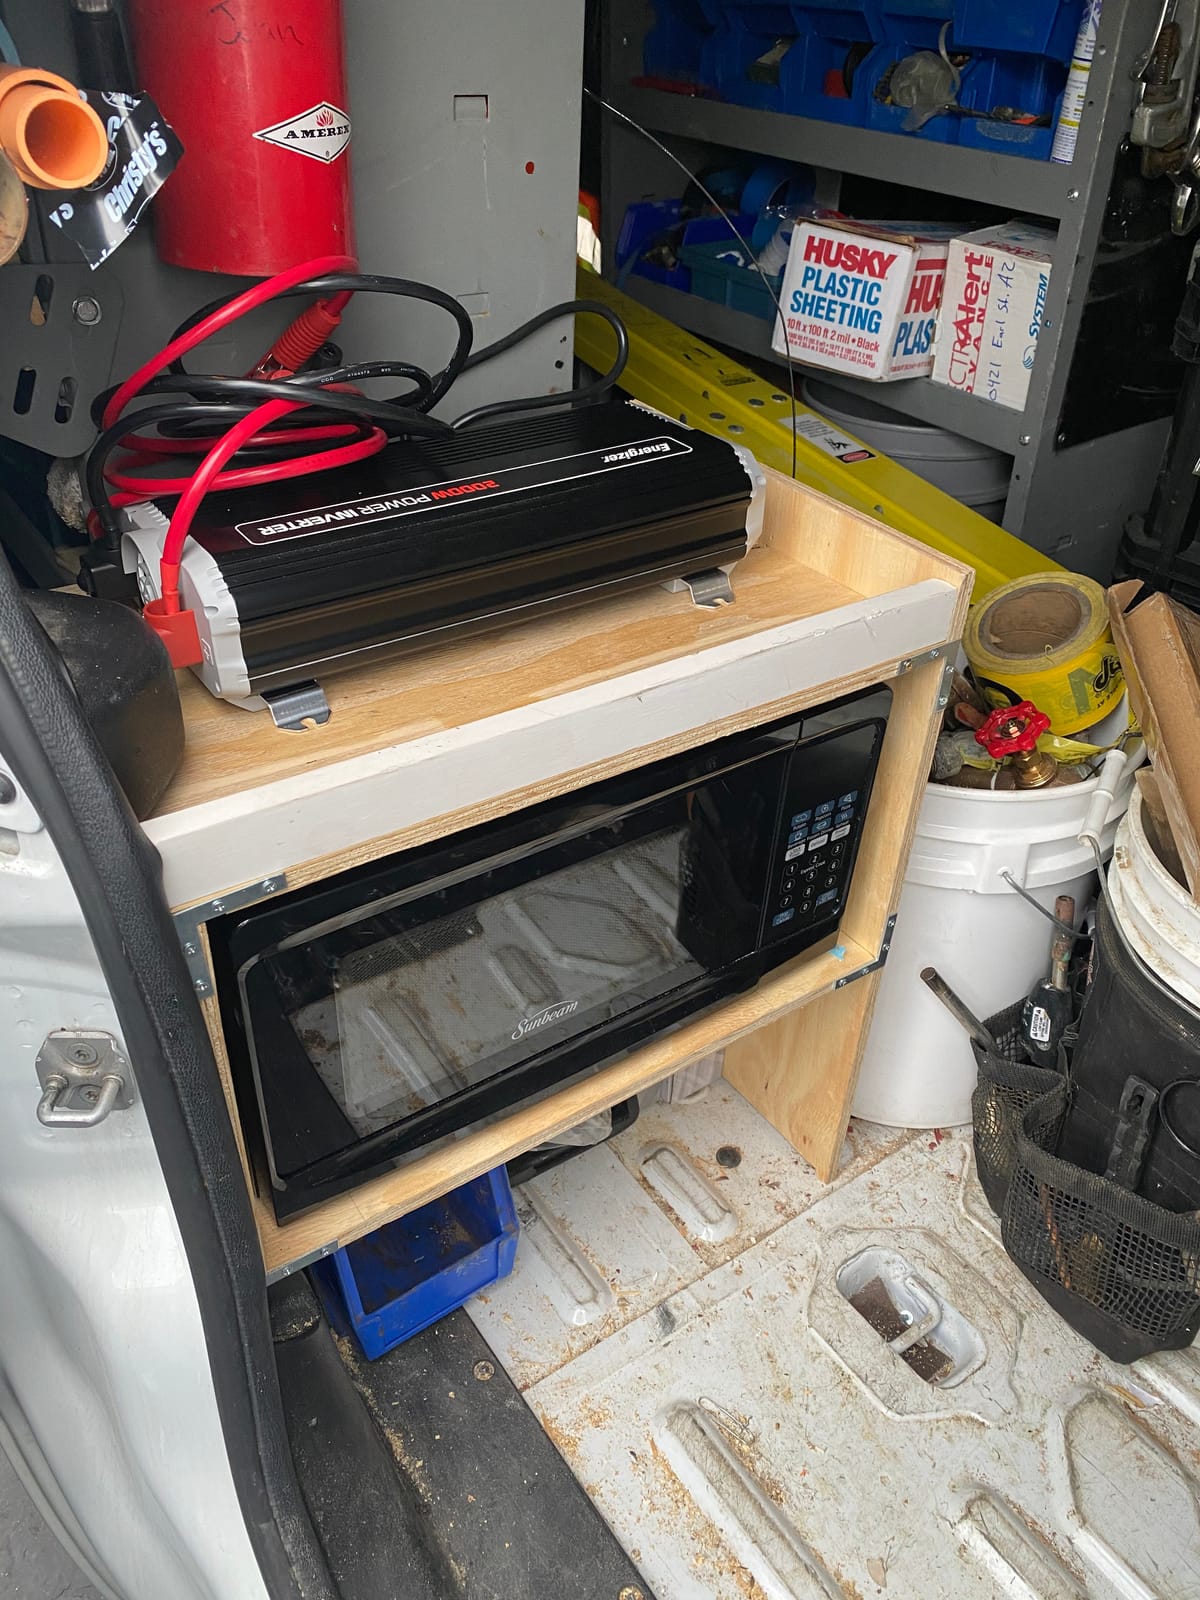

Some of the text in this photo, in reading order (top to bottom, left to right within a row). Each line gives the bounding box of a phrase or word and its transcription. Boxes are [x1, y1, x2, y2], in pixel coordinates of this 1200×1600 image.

[284, 125, 350, 139] AMEREX
[104, 129, 168, 223] Christy's
[804, 235, 897, 279] HUSKY
[801, 266, 882, 306] PLASTIC
[1029, 273, 1048, 341] SYSTEM
[790, 290, 882, 334] SHEETING
[809, 324, 822, 337] 100
[830, 329, 836, 341] 2
[837, 332, 851, 345] mil
[857, 337, 880, 353] Black
[602, 442, 671, 463] Energizer
[257, 479, 500, 536] 2000W POWER INVERTER
[511, 1000, 578, 1040] Sunbeam
